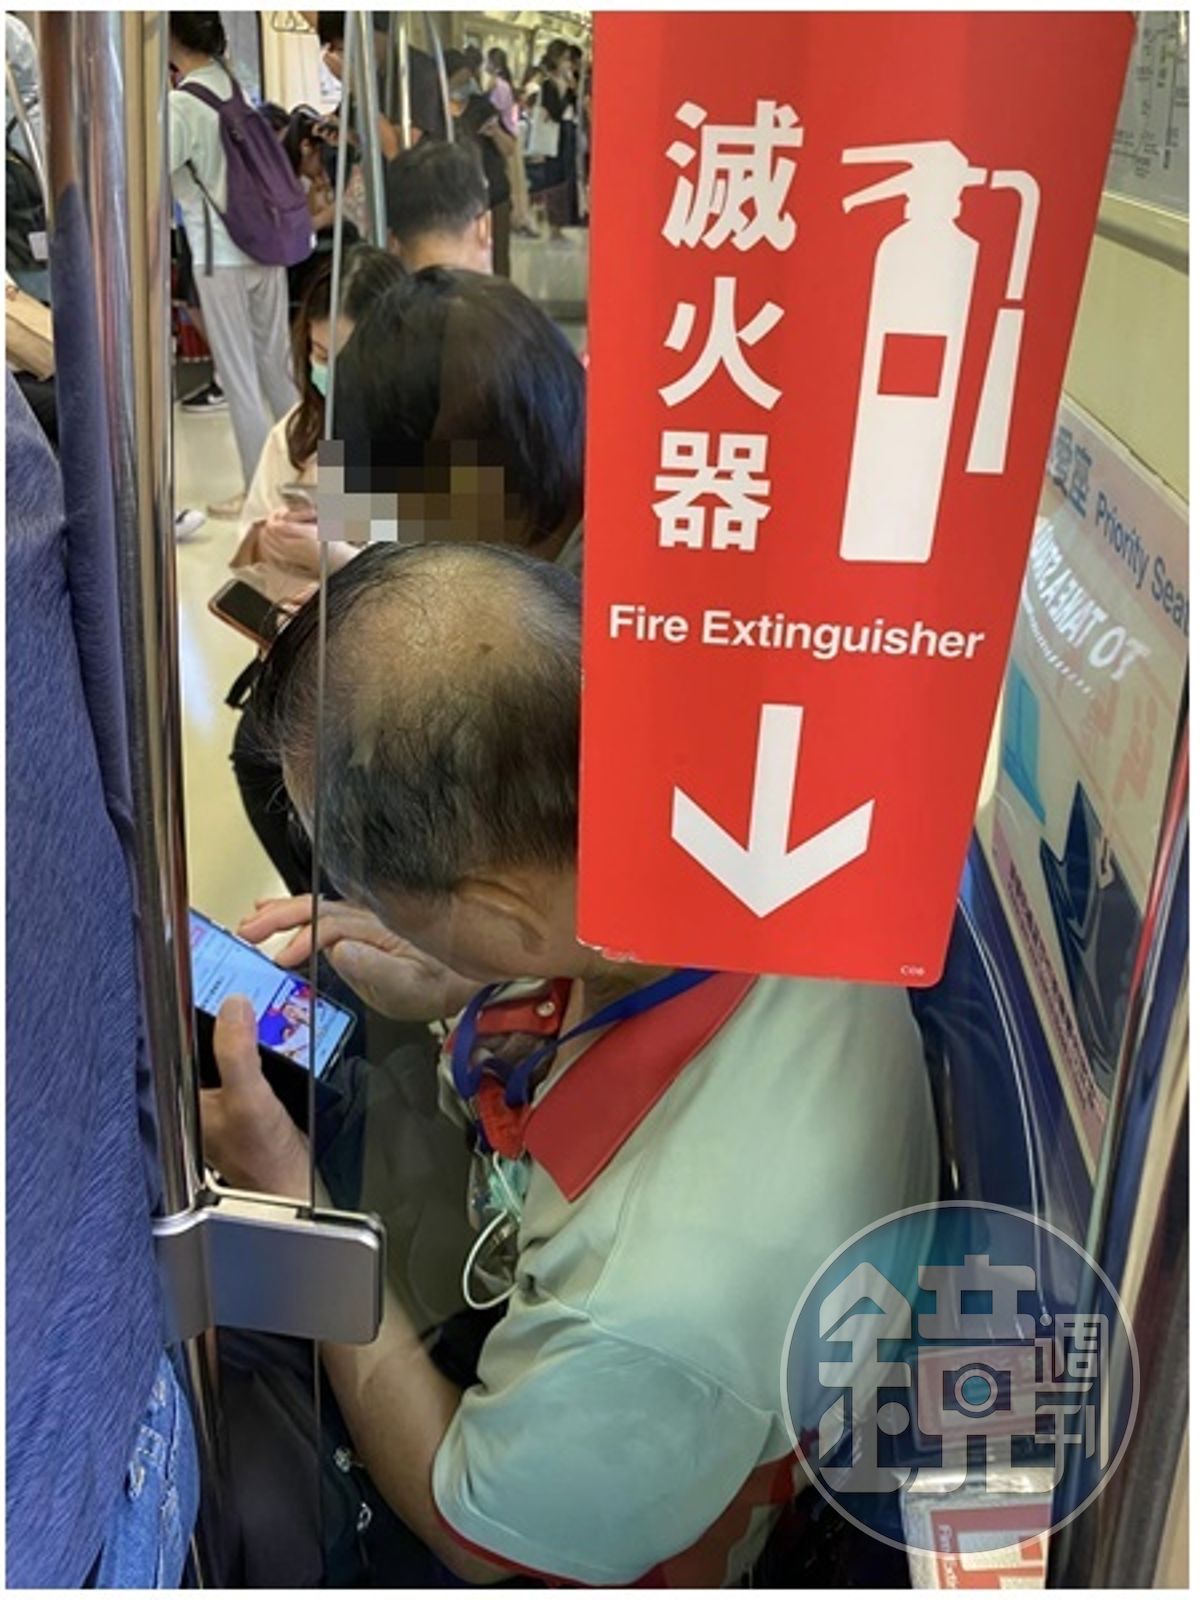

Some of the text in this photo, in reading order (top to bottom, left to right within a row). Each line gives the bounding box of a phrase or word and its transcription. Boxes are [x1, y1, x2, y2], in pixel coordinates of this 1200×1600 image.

[652, 99, 805, 552] 滅火器
[1095, 490, 1150, 589] Priority
[609, 603, 689, 643] Fire
[702, 608, 985, 661] Extinguisher
